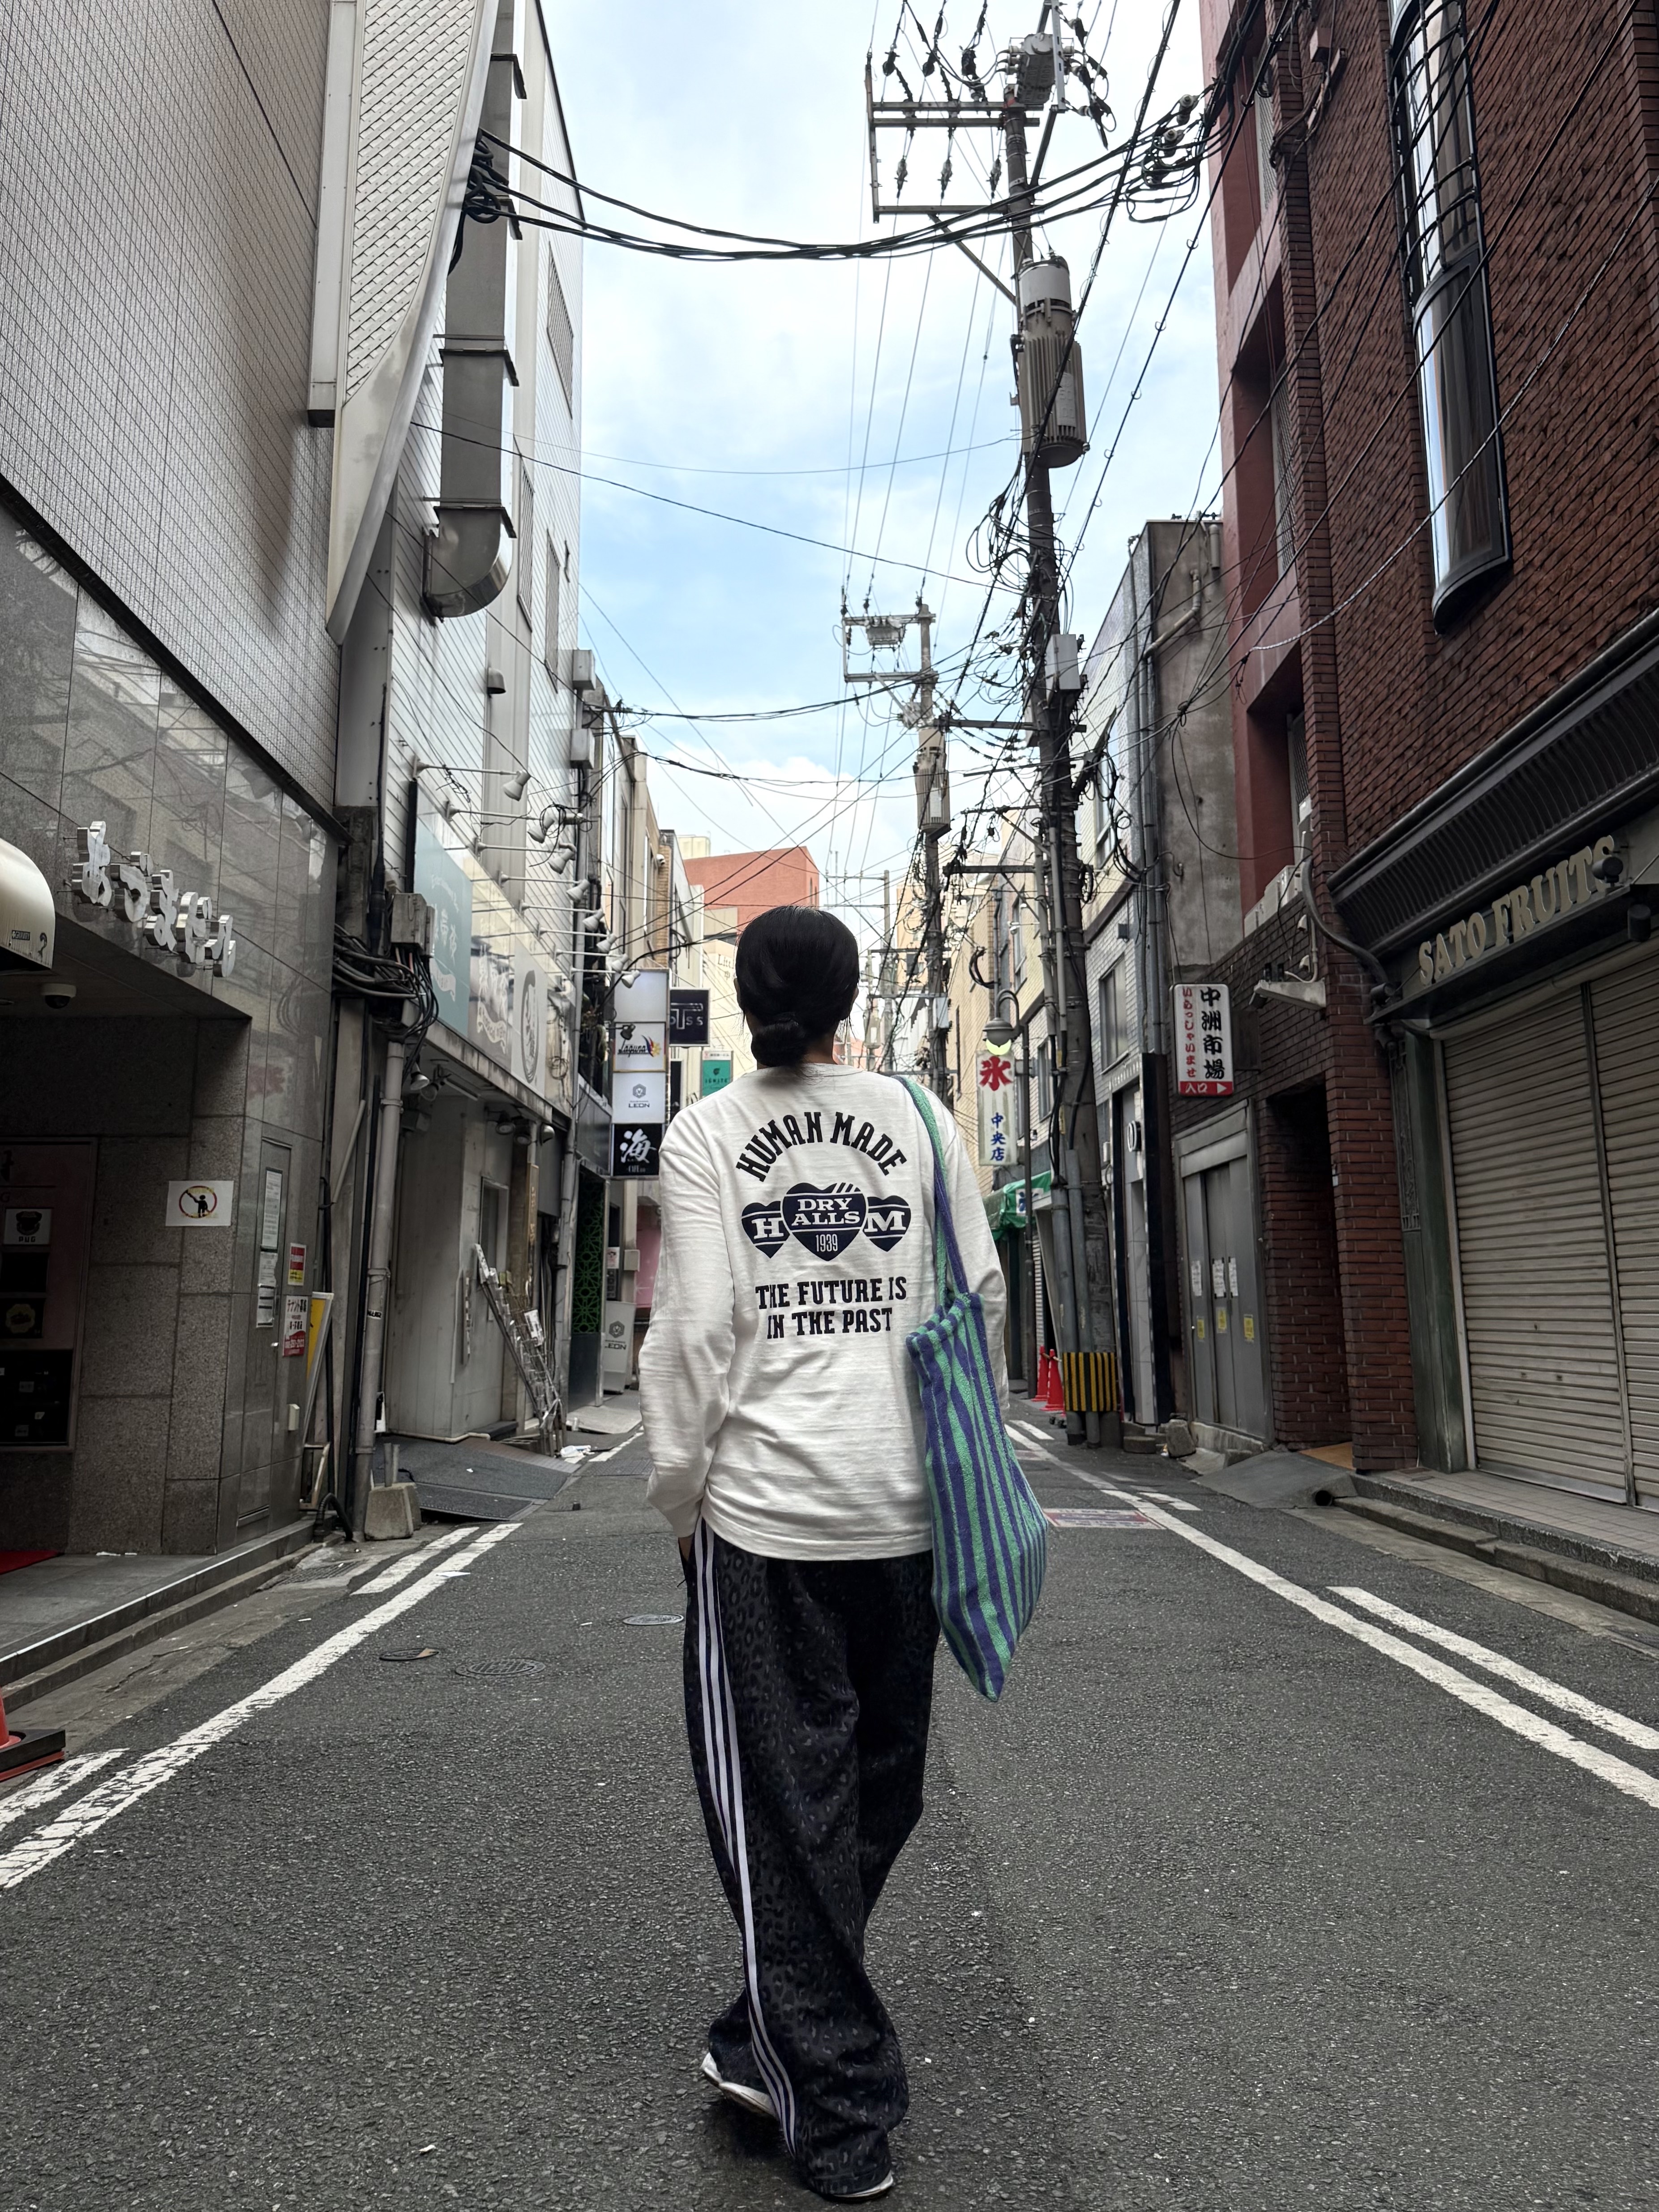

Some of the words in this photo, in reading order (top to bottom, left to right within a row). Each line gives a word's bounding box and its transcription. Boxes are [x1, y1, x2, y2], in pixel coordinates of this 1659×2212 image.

[1418, 912, 1487, 986] SATO
[1492, 835, 1614, 947] FRUITS
[1182, 987, 1197, 1078] いらっしゃいませ
[1200, 987, 1225, 1080] 中洲市場
[979, 1055, 1012, 1091] 氷
[1185, 1082, 1208, 1093] 入口
[736, 1112, 823, 1182] HUMAN
[830, 1111, 907, 1176] MADE
[990, 1112, 1007, 1162] 中央店
[791, 1211, 861, 1226] ALLS
[797, 1197, 853, 1211] DRY
[751, 1217, 784, 1240] H
[865, 1210, 907, 1232] M
[816, 1234, 838, 1252] 1939
[755, 1284, 790, 1309] THE
[798, 1278, 883, 1305] FUTURE
[889, 1276, 907, 1300] IS
[767, 1315, 784, 1339] IN
[792, 1310, 836, 1336] THE
[842, 1307, 893, 1333] PAST
